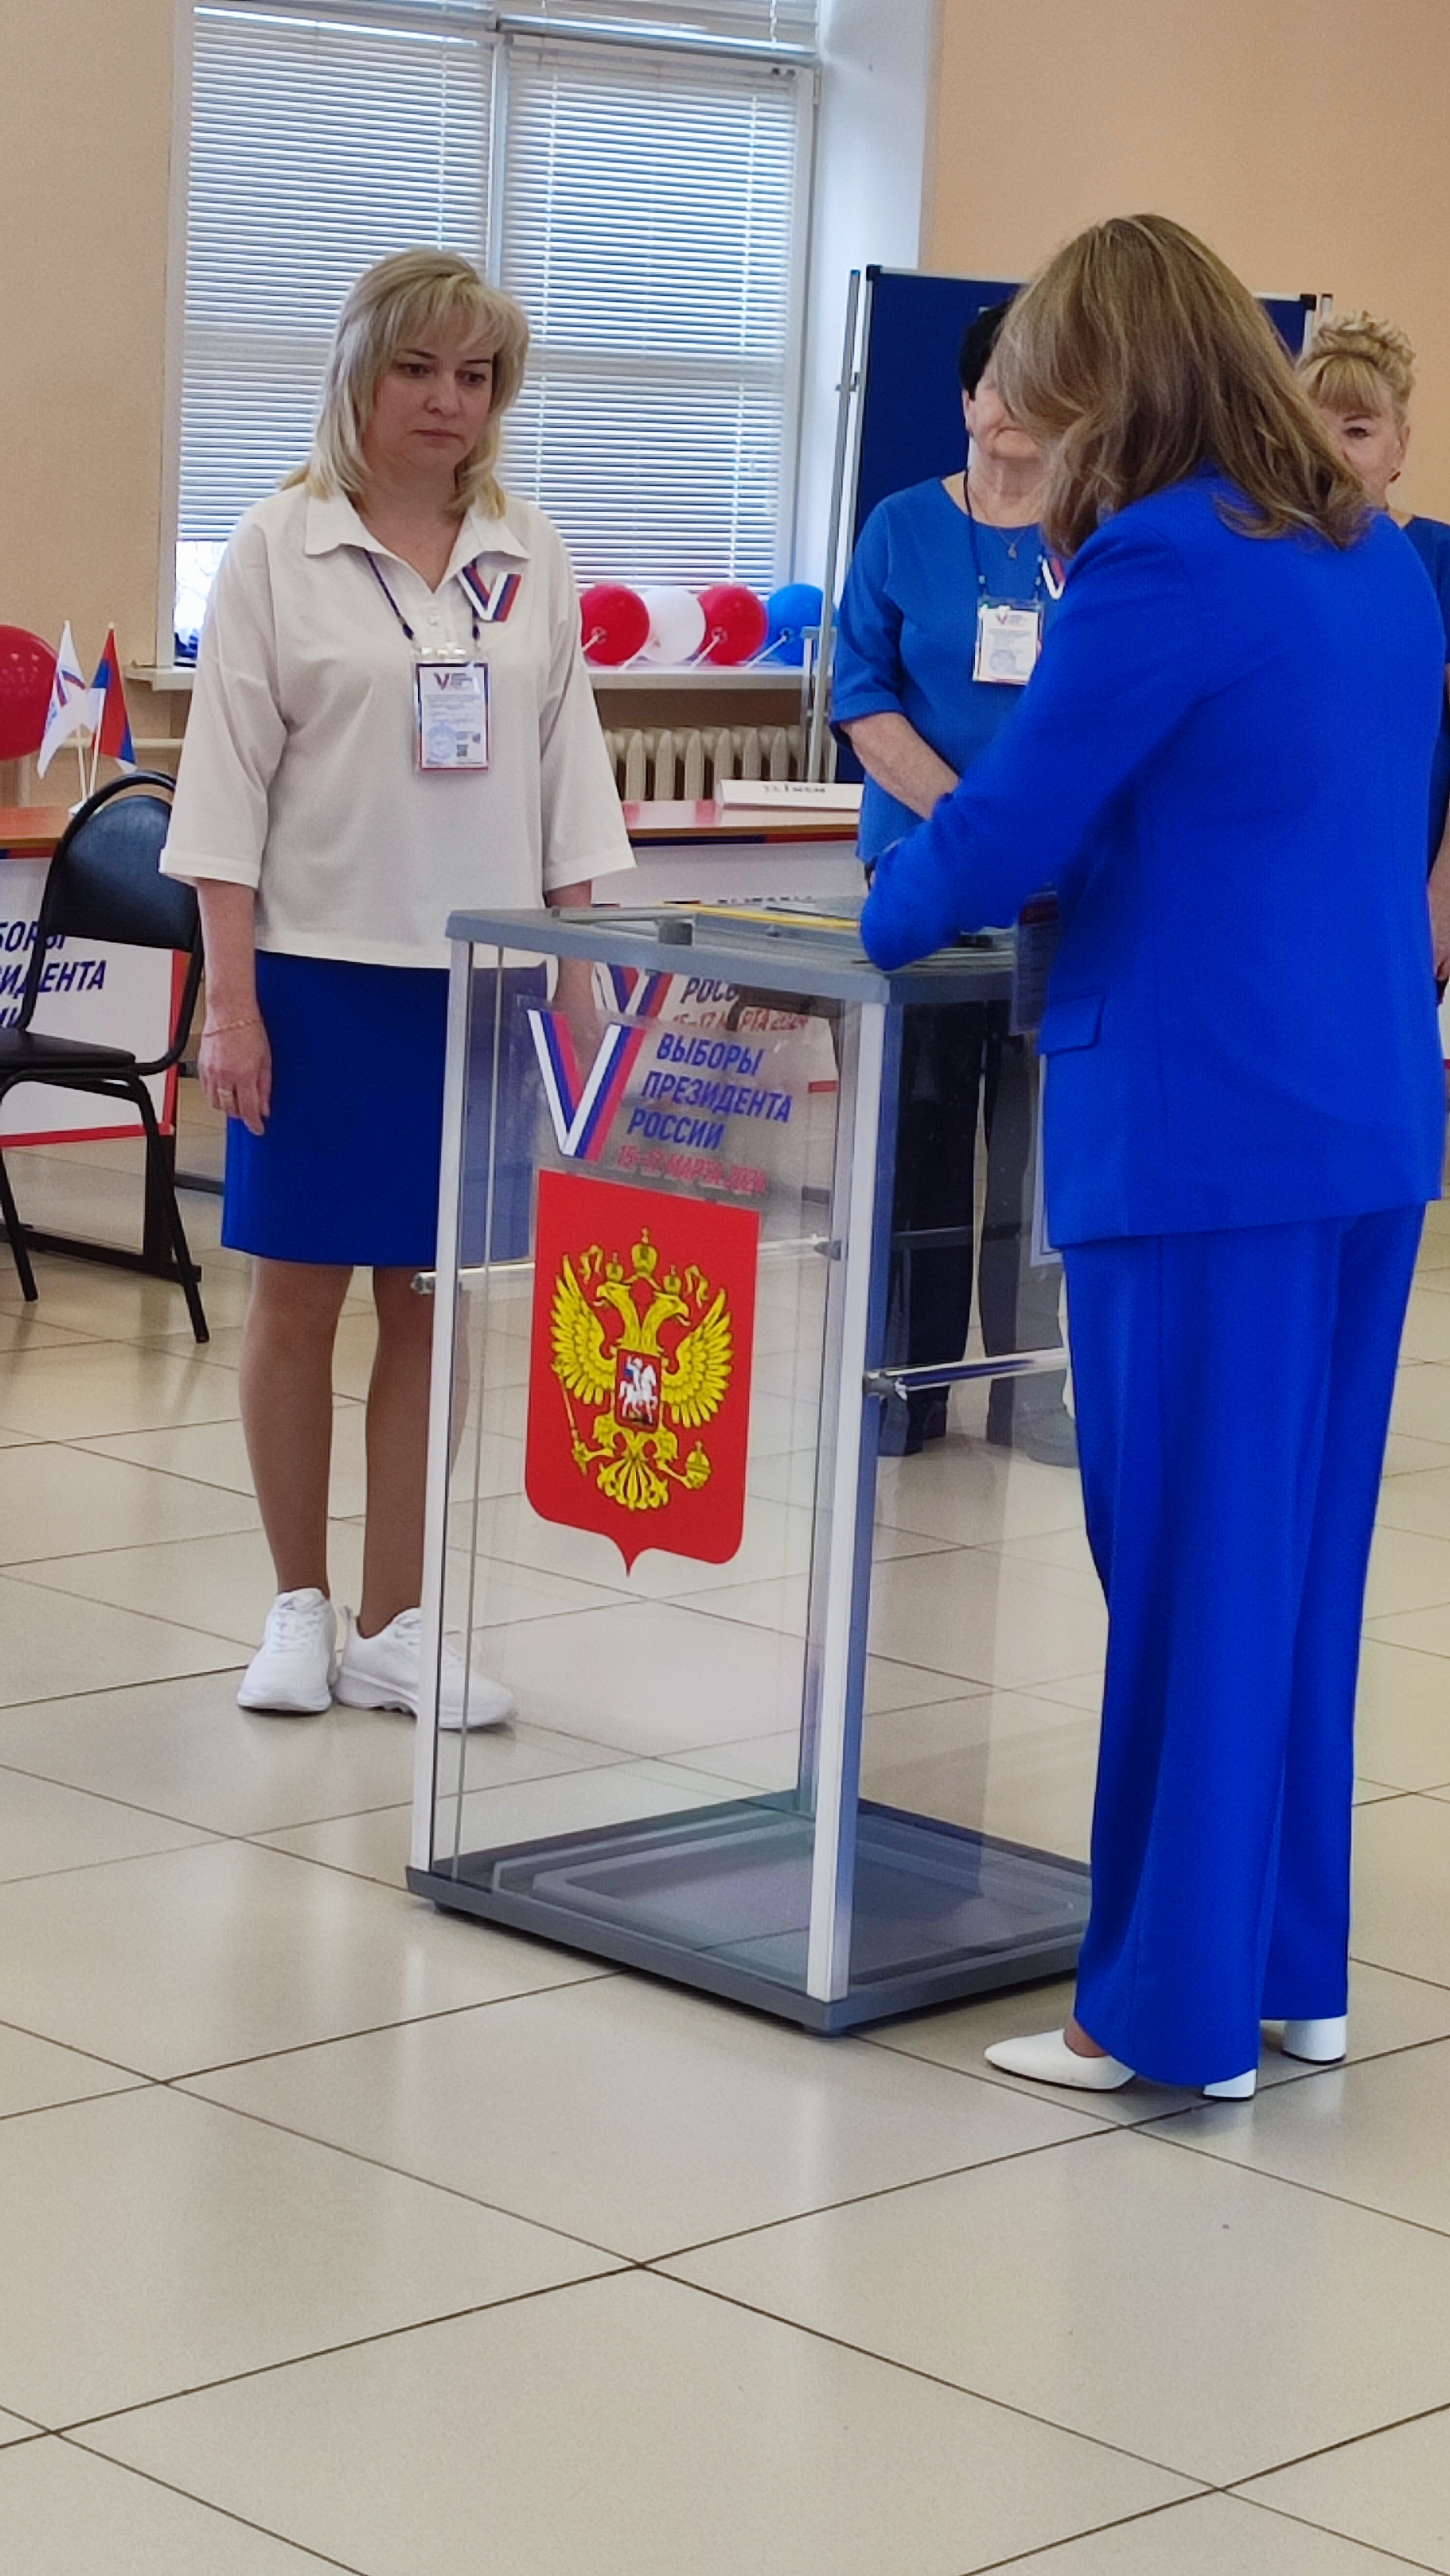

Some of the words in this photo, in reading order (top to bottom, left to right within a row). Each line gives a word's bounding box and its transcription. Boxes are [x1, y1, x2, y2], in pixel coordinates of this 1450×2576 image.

[0, 960, 106, 999] ИЕНТА
[656, 1032, 764, 1076] ВЫБОРЫ
[641, 1070, 791, 1122] ПРЕЗИДЕНТА
[627, 1108, 725, 1150] РОССИИ
